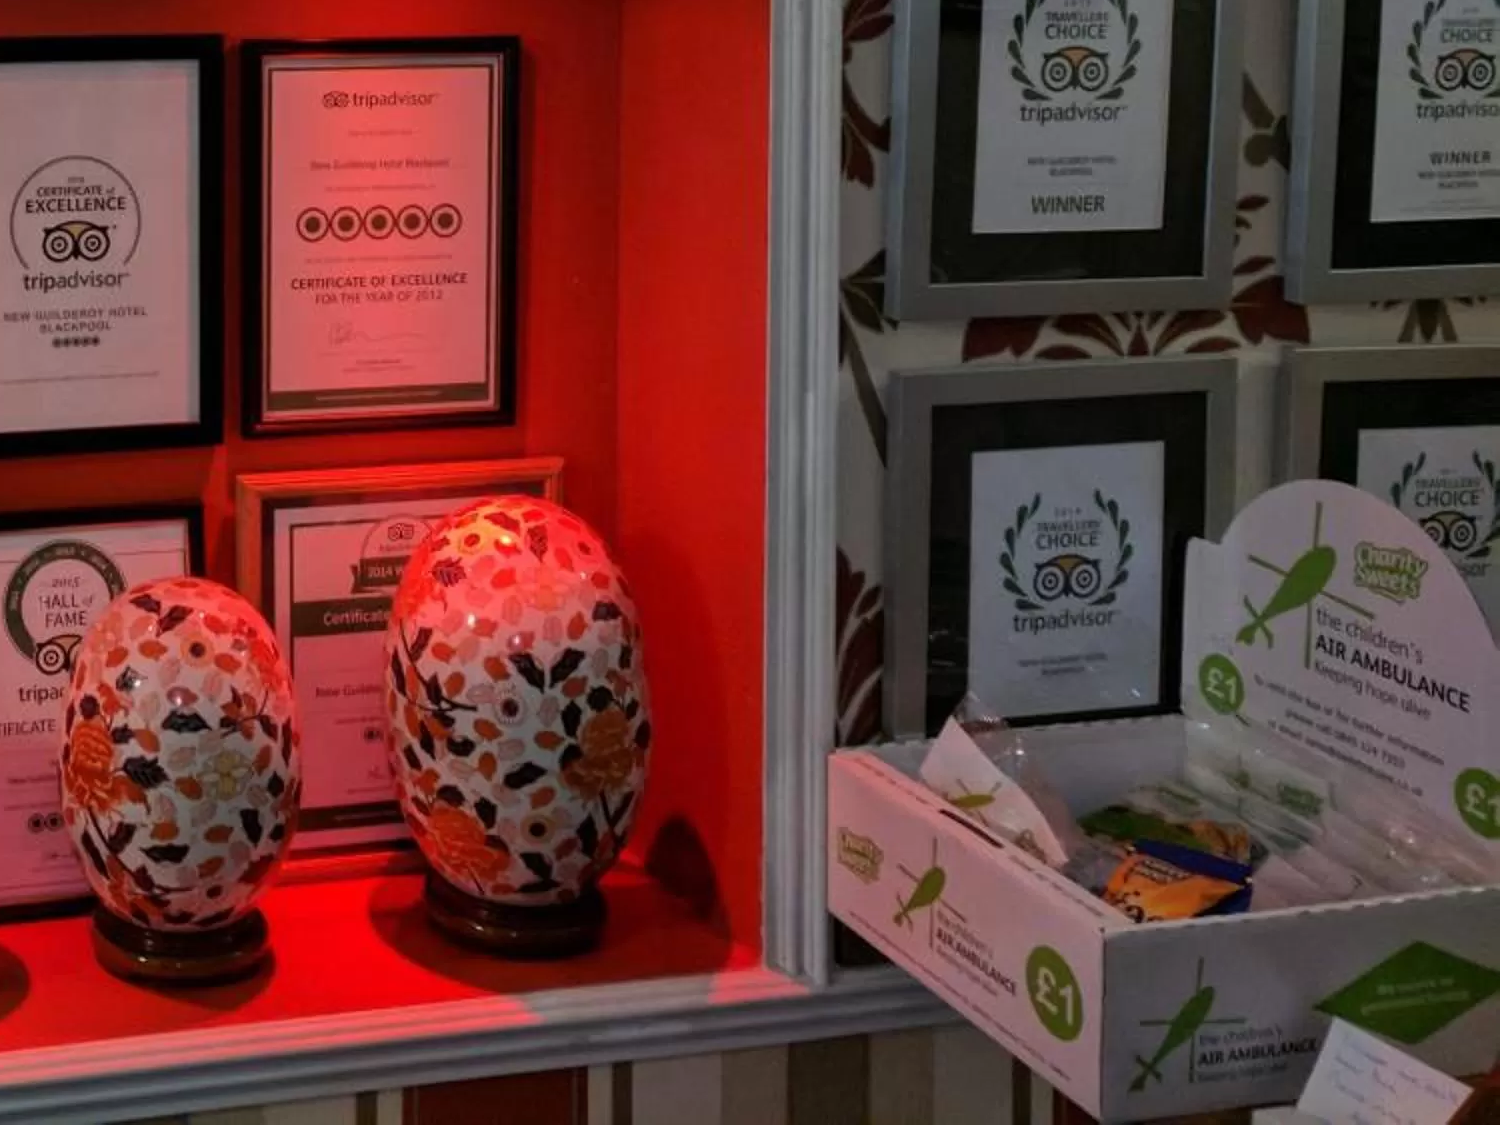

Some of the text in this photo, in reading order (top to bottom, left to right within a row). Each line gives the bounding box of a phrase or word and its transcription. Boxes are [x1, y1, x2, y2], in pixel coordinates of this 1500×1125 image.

[1044, 23, 1108, 40] CHOICE
[1439, 27, 1494, 44] CHOICE
[352, 91, 435, 110] tripadvisor
[1020, 103, 1122, 126] tripadvisor
[1429, 150, 1492, 166] WINNER
[36, 185, 103, 198] CERTIFICATE
[25, 196, 127, 214] EXCELLENCE
[1031, 195, 1106, 215] WINNER
[23, 271, 125, 293] tripadvisor
[290, 272, 469, 291] CERTIFICATE OF EXCELLENCE
[315, 289, 444, 306] FOR THE YEAR OF 2012
[108, 306, 148, 318] HOTEL
[1414, 490, 1481, 508] CHOICE
[1035, 531, 1100, 550] CHOICE
[1357, 545, 1428, 578] Charity
[1357, 565, 1418, 598] Sweets
[39, 594, 80, 611] HALL
[45, 611, 88, 628] FAME
[1013, 609, 1114, 635] tripadvisor
[1316, 608, 1342, 632] the
[1315, 634, 1347, 662] AIR
[1350, 649, 1471, 713] AMBULANCE
[1205, 666, 1238, 706] £1
[1034, 966, 1075, 1027] £1
[1198, 1037, 1318, 1067] AIR AMBULANCE
